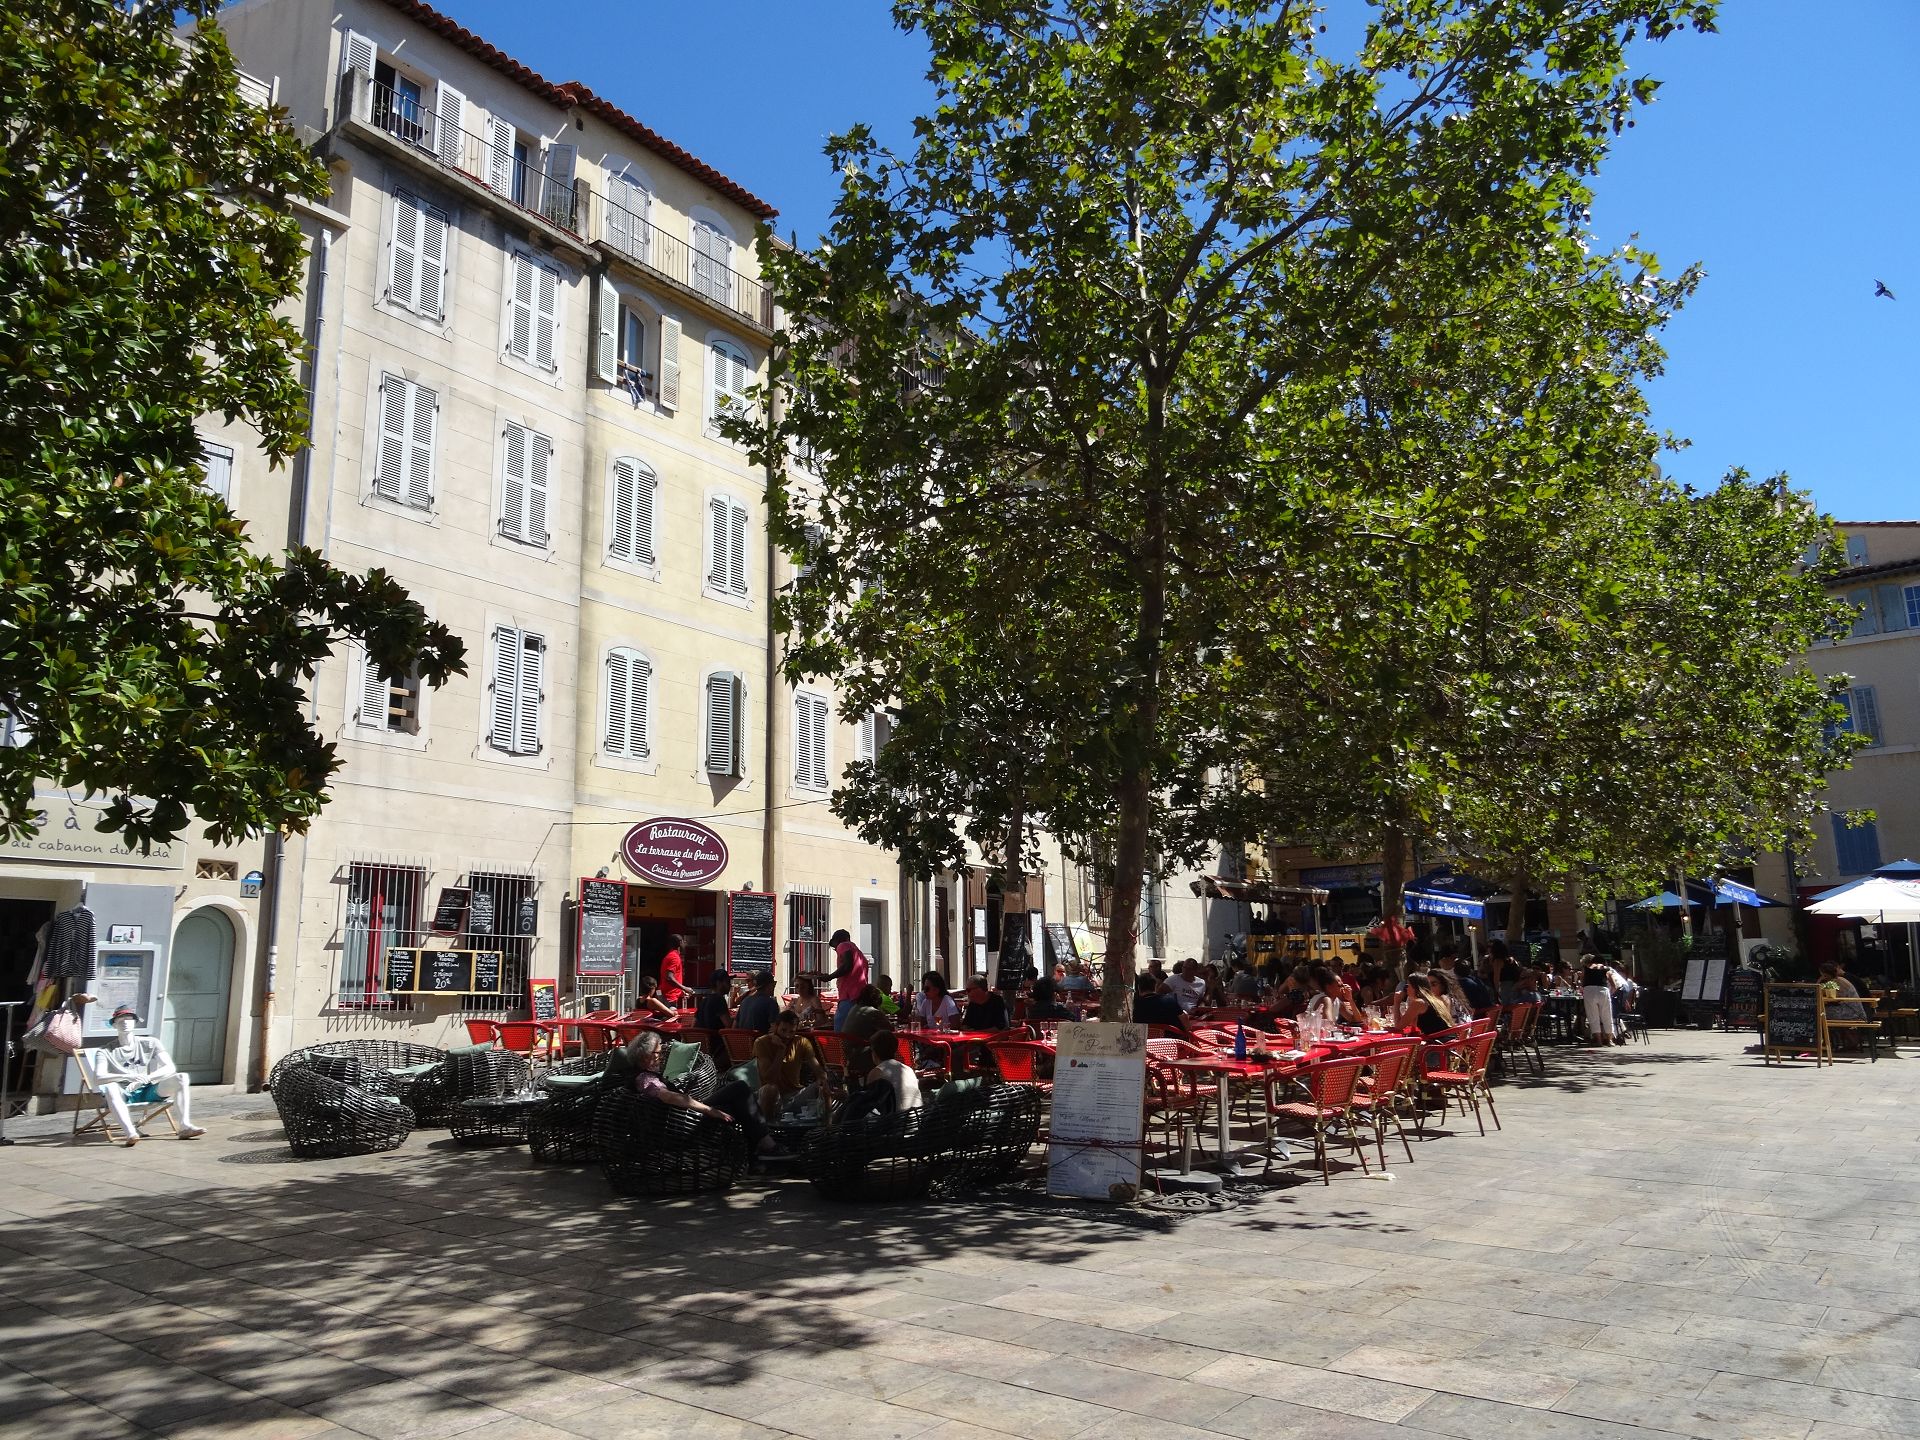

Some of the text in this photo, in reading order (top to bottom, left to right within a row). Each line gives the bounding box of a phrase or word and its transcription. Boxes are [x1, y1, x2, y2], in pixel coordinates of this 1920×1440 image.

[649, 826, 708, 846] Restaurant
[11, 838, 171, 859] au cabanon du Fda
[634, 843, 719, 861] La terrasse du Panier
[651, 863, 704, 879] Cuisine de Provence
[243, 884, 257, 895] 12
